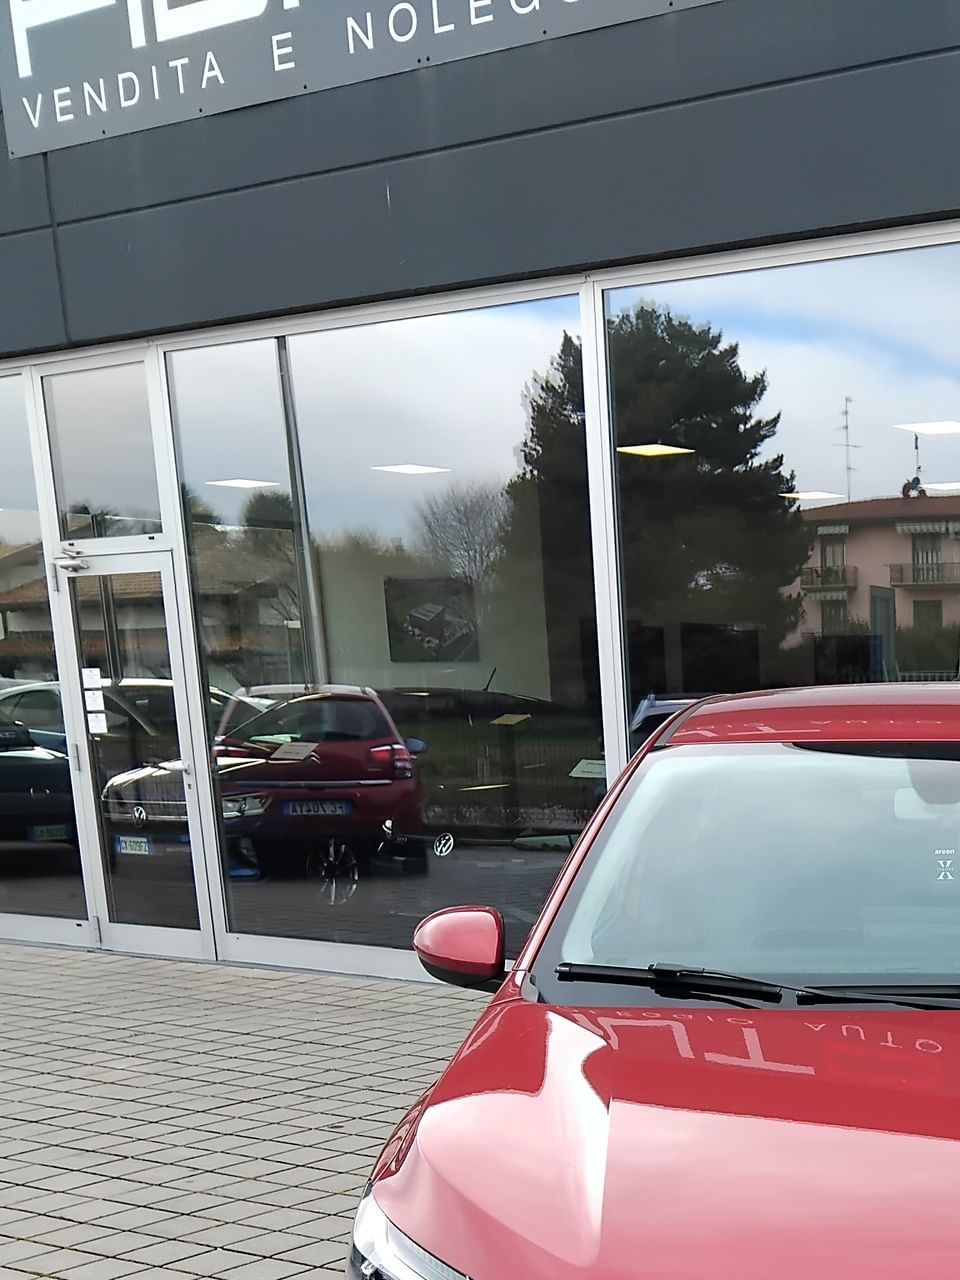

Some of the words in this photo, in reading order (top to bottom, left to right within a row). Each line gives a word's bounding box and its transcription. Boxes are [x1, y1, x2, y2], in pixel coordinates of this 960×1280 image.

[22, 51, 225, 128] VENDITA
[271, 32, 296, 72] E
[346, 0, 583, 54] NOLE
